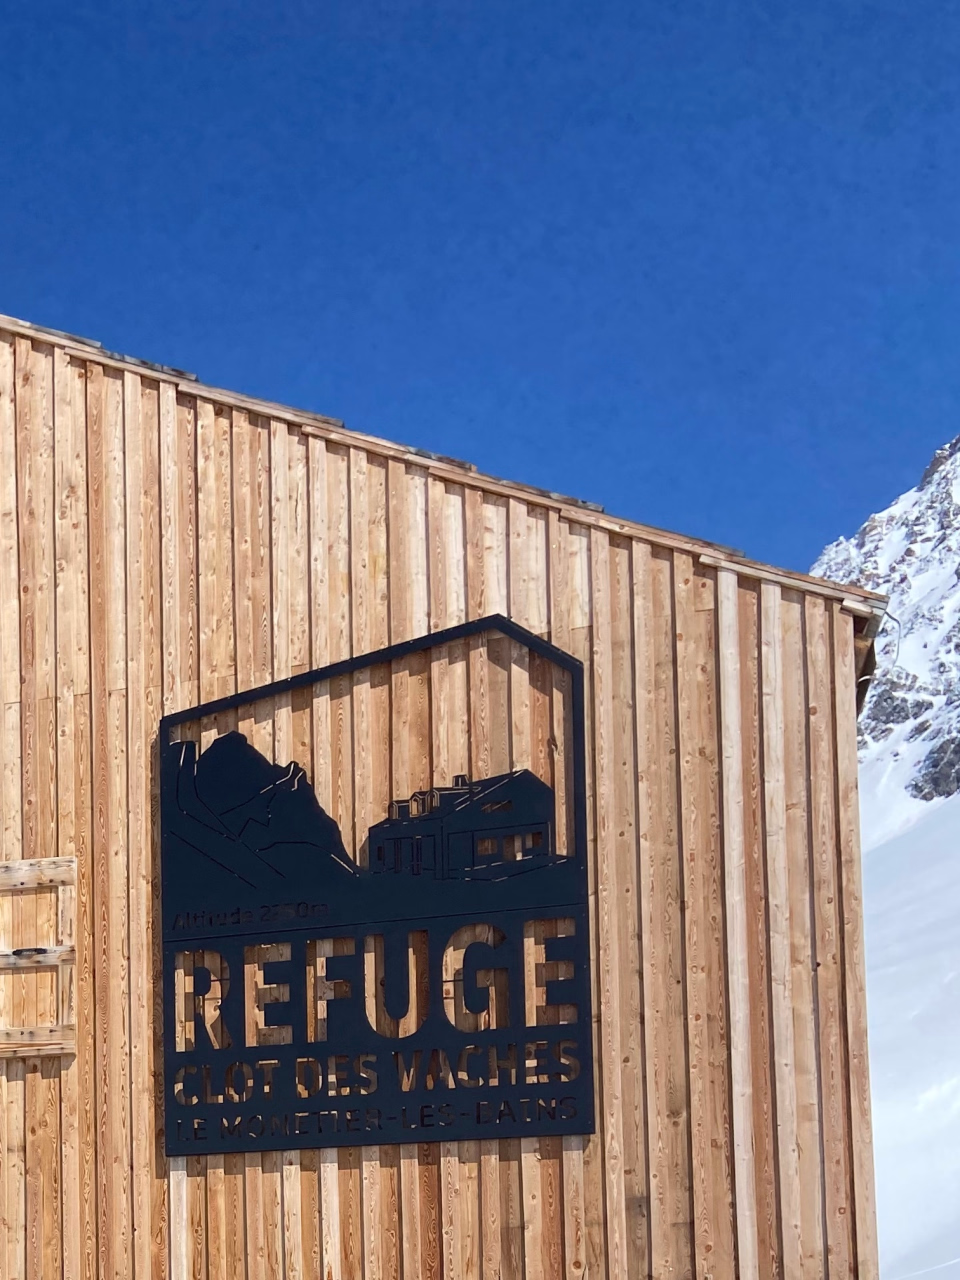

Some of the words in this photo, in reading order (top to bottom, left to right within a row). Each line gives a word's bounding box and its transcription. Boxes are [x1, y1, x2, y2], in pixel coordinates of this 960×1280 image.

[172, 907, 253, 930] Altitude
[175, 917, 578, 1053] REFUGE
[174, 1060, 281, 1106] CLOT
[296, 1054, 378, 1098] DES
[393, 1040, 581, 1091] VACHES
[177, 1118, 208, 1141] LE
